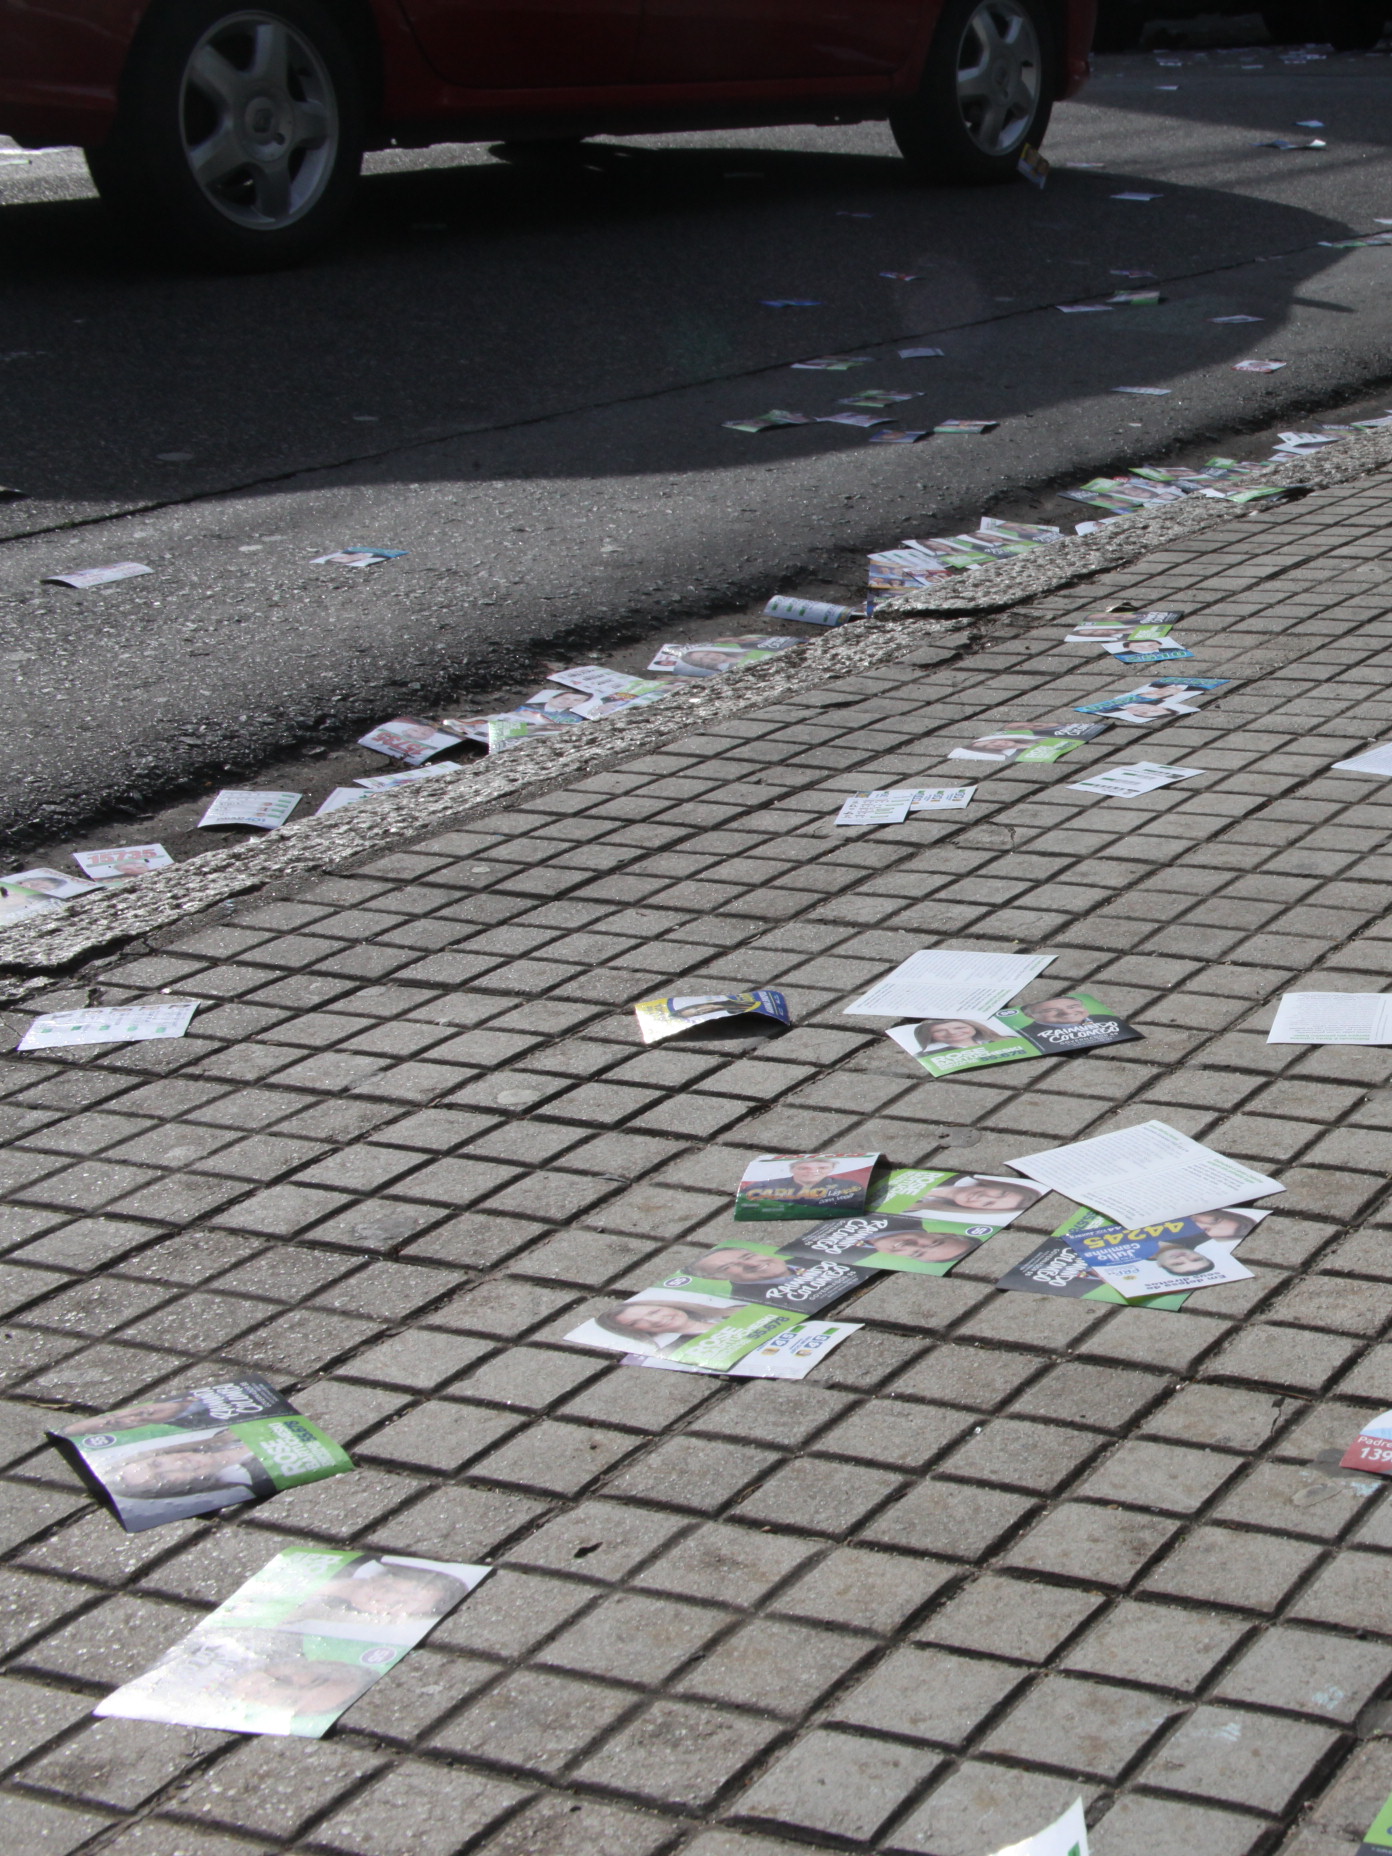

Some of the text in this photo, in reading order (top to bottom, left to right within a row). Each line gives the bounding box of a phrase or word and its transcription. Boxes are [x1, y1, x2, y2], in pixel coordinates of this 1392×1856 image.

[88, 848, 156, 865] 15735
[1037, 1021, 1118, 1038] RAIMUNDO
[1049, 1027, 1120, 1043] COLOMBO
[930, 1047, 987, 1066] ROSE
[747, 1187, 827, 1201] CARLÃO
[811, 1219, 868, 1250] COLOMBO
[825, 1219, 888, 1254] RAIMUNDO
[970, 1227, 987, 1236] 55
[1085, 1243, 1141, 1258] Caminha
[671, 1278, 686, 1286] 55
[766, 1260, 838, 1300] RAIMUNDO
[786, 1265, 852, 1301] COLOMBO
[747, 1316, 790, 1341] 55.678
[692, 1325, 742, 1356] ROSE
[774, 1333, 797, 1347] 45
[808, 1334, 832, 1350] 45
[192, 1387, 239, 1420] RAIMUNDO
[213, 1382, 263, 1414] COLOMBO
[260, 1439, 303, 1477] ROSE
